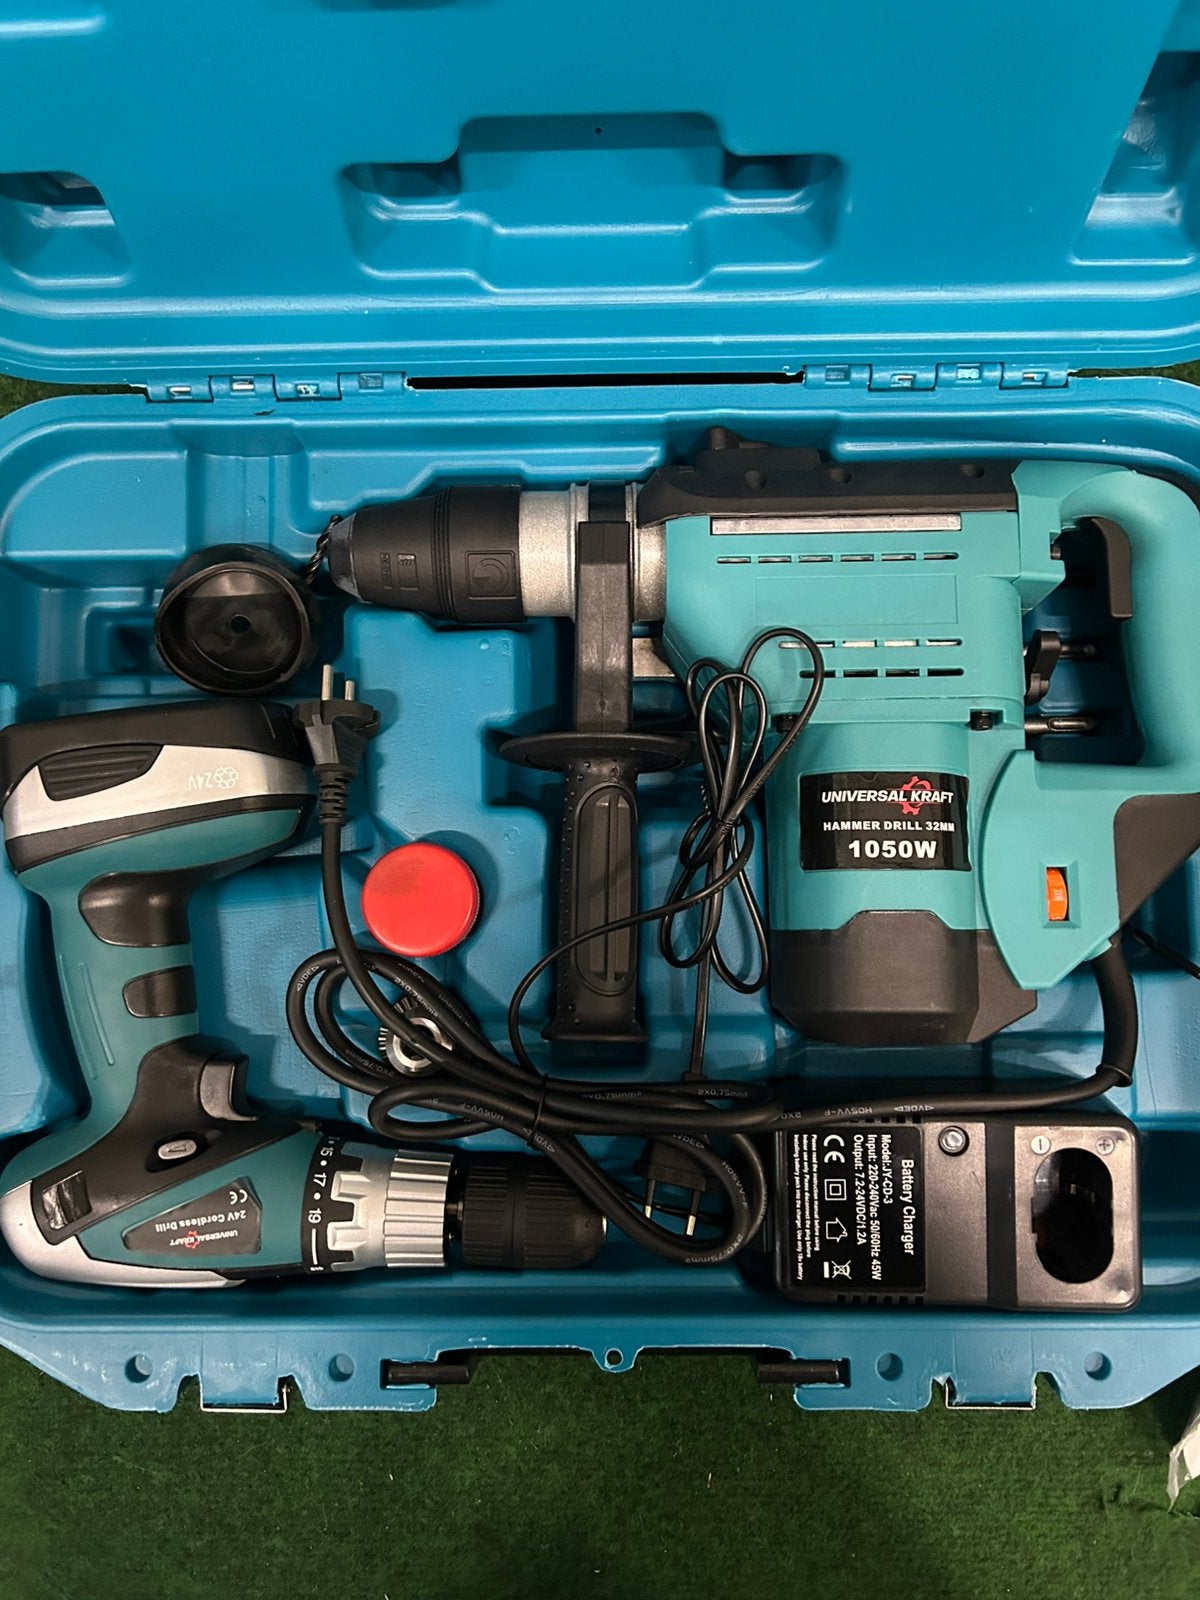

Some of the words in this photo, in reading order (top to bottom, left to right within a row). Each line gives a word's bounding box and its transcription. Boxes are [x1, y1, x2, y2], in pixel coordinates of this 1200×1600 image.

[188, 772, 213, 791] 24V
[822, 790, 908, 803] UNIVERSAL
[911, 790, 953, 803] KRAFT
[823, 821, 880, 831] HAMMER
[884, 821, 922, 831] DRILL
[849, 840, 937, 858] 1050W
[320, 1147, 334, 1157] 15
[823, 1134, 845, 1163] CE
[852, 1134, 864, 1170] Output:
[866, 1134, 878, 1162] Input:
[881, 1134, 893, 1204] Model:JY-CD-3
[313, 1173, 327, 1187] 17
[900, 1159, 914, 1203] Battery
[868, 1165, 880, 1218] 220-240Vac
[228, 1209, 247, 1221] 24V
[308, 1208, 322, 1223] 19
[854, 1172, 867, 1245] 7.2-24VDC/1.2A
[155, 1221, 178, 1232] Drill
[179, 1214, 225, 1227] Cordless
[196, 1229, 238, 1244] UNIVERSAL
[870, 1220, 881, 1257] 50/60Hz
[901, 1206, 916, 1255] Charger
[872, 1259, 882, 1280] 45W
